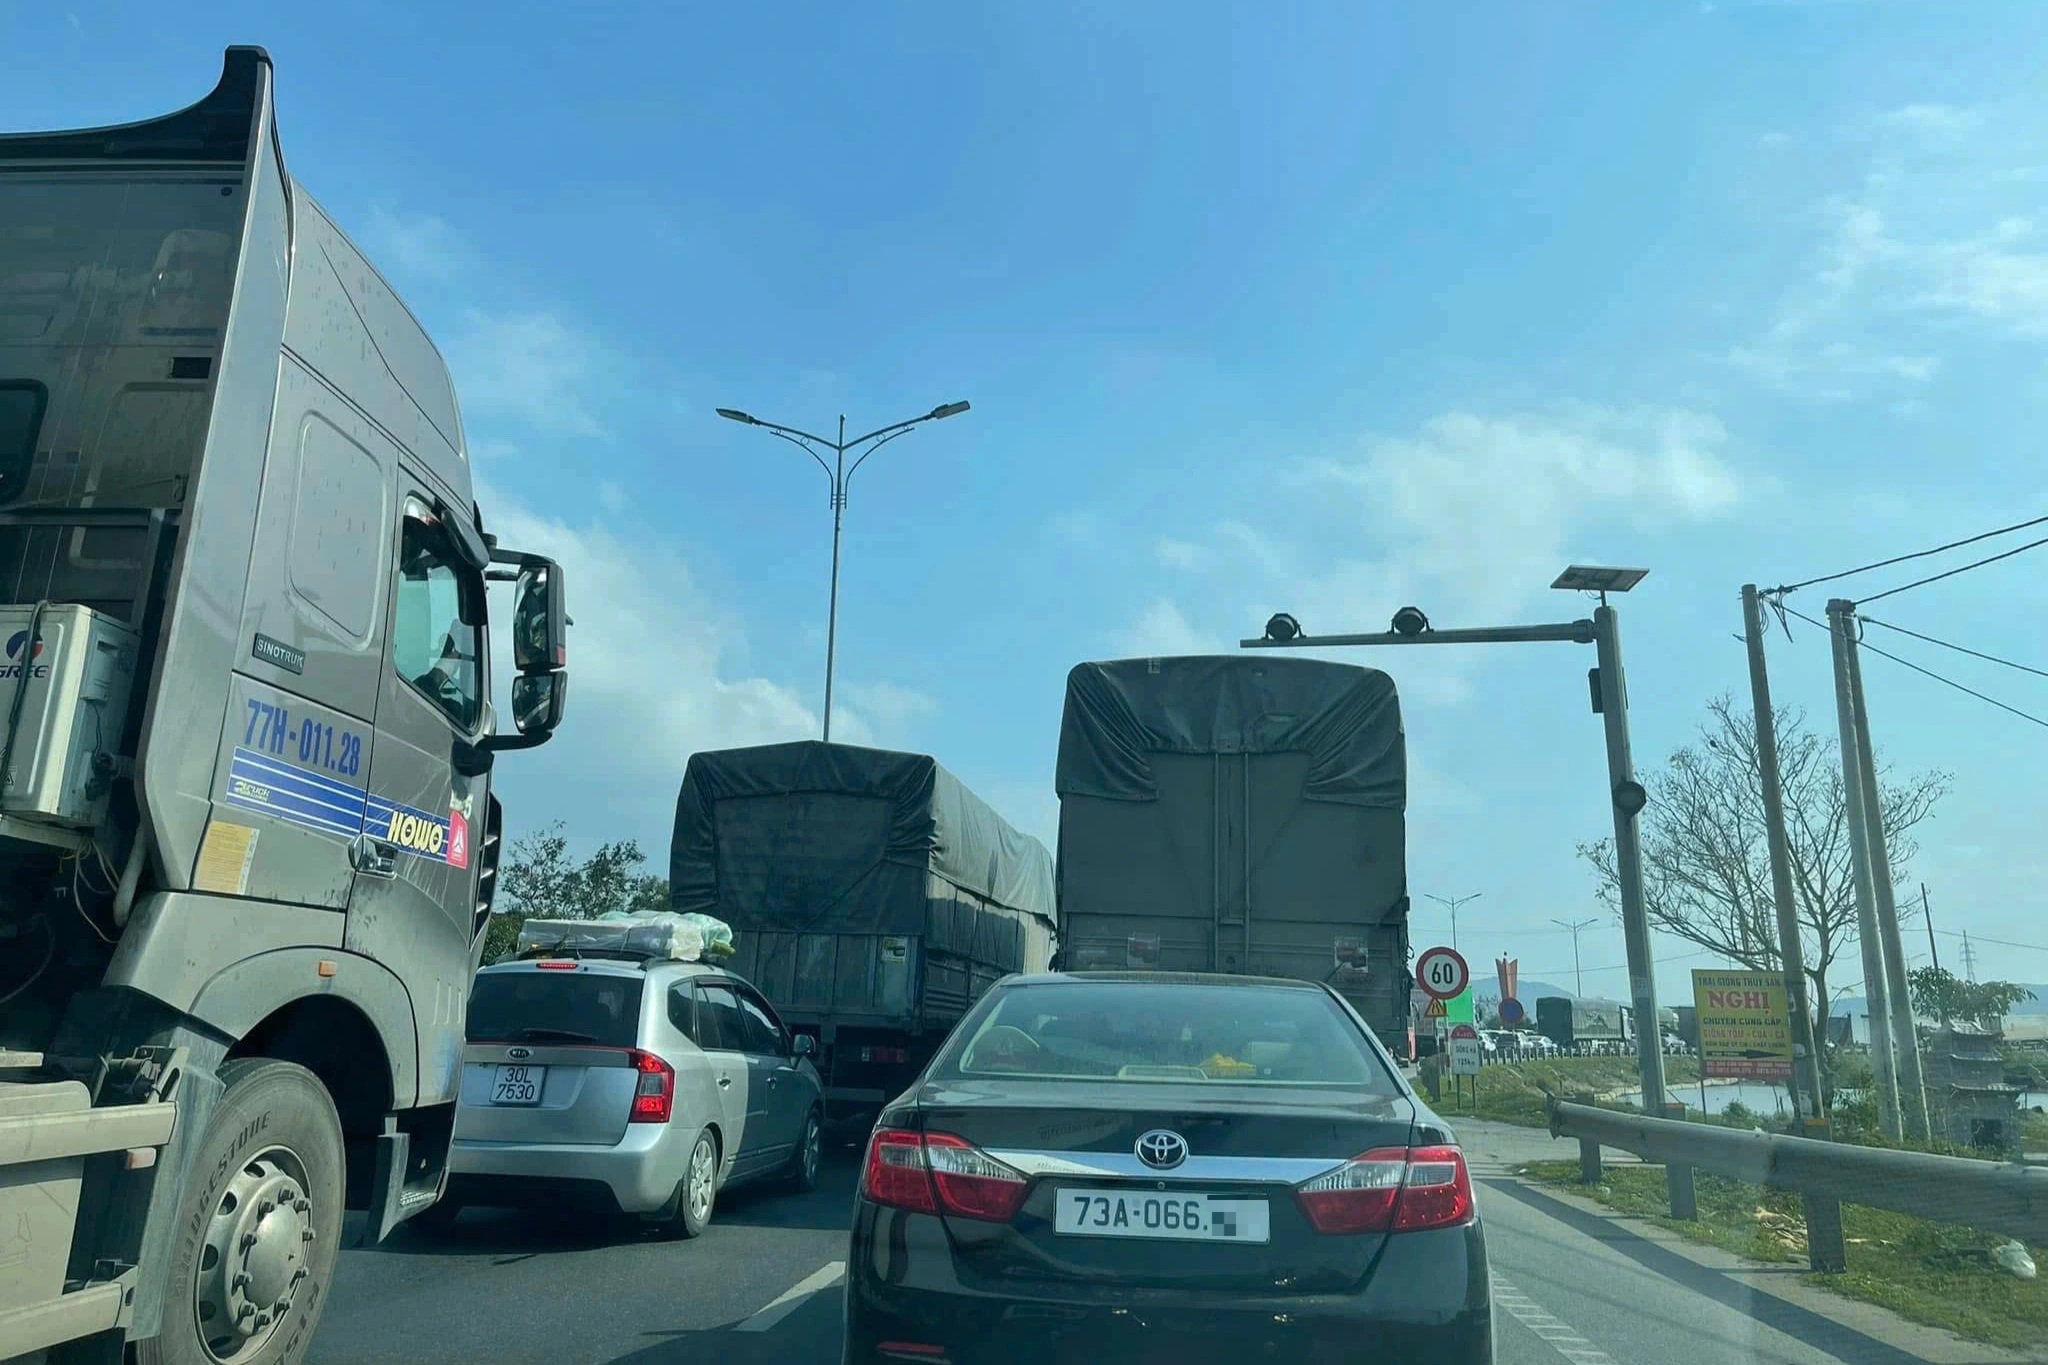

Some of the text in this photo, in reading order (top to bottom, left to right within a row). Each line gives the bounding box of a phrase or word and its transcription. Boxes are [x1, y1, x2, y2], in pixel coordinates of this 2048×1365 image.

[256, 638, 304, 668] SINOTRUK
[244, 698, 361, 777] 77H-011.28
[387, 810, 443, 854] HOWO
[1431, 962, 1453, 985] 60
[1707, 990, 1771, 1014] NGHỊ
[511, 1049, 528, 1058] KIA
[504, 1067, 532, 1084] 30L
[496, 1083, 535, 1100] 7530
[1073, 1196, 1242, 1237] 73A-066.
